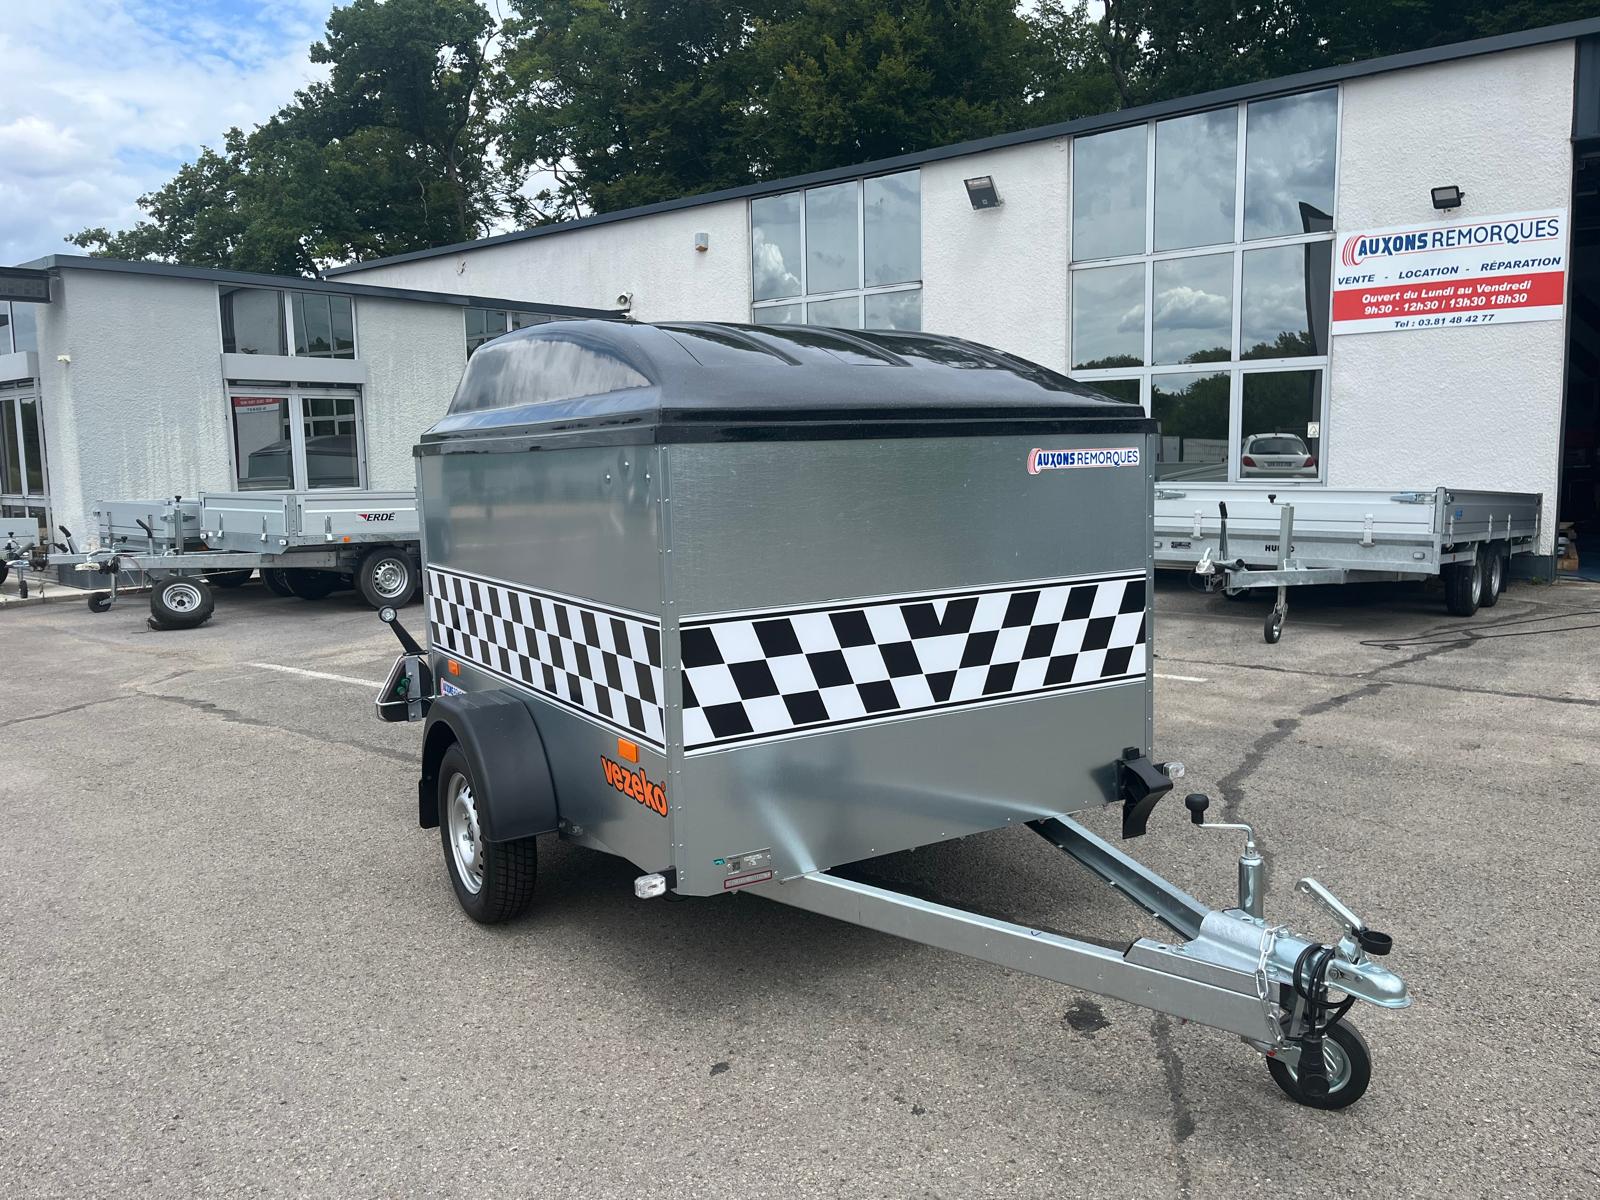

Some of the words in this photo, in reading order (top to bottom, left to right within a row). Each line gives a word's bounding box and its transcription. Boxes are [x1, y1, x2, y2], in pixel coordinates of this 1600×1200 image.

[1358, 233, 1428, 256] AUXONS
[1432, 219, 1559, 248] REMORQUES
[1338, 274, 1375, 285] VENTE
[1399, 266, 1459, 280] LOCATION
[1480, 257, 1561, 272] RÉPARATION
[1362, 292, 1400, 303] Ouvert
[1404, 290, 1418, 299] du
[1421, 286, 1454, 298] Lundi
[1476, 280, 1532, 293] Vendredi
[1364, 304, 1393, 315] 9h30
[1403, 300, 1438, 312] 12h30
[1449, 296, 1485, 308] 13h30
[1490, 293, 1528, 305] 18h30
[1418, 317, 1446, 327] 03.81
[1449, 316, 1462, 324] 48
[1465, 315, 1479, 323] 42
[1482, 314, 1495, 322] 77
[1037, 452, 1075, 468] AUXONS
[1077, 450, 1139, 466] REMORQUES
[366, 512, 396, 522] ERDÉ
[600, 754, 668, 818] vezeko
